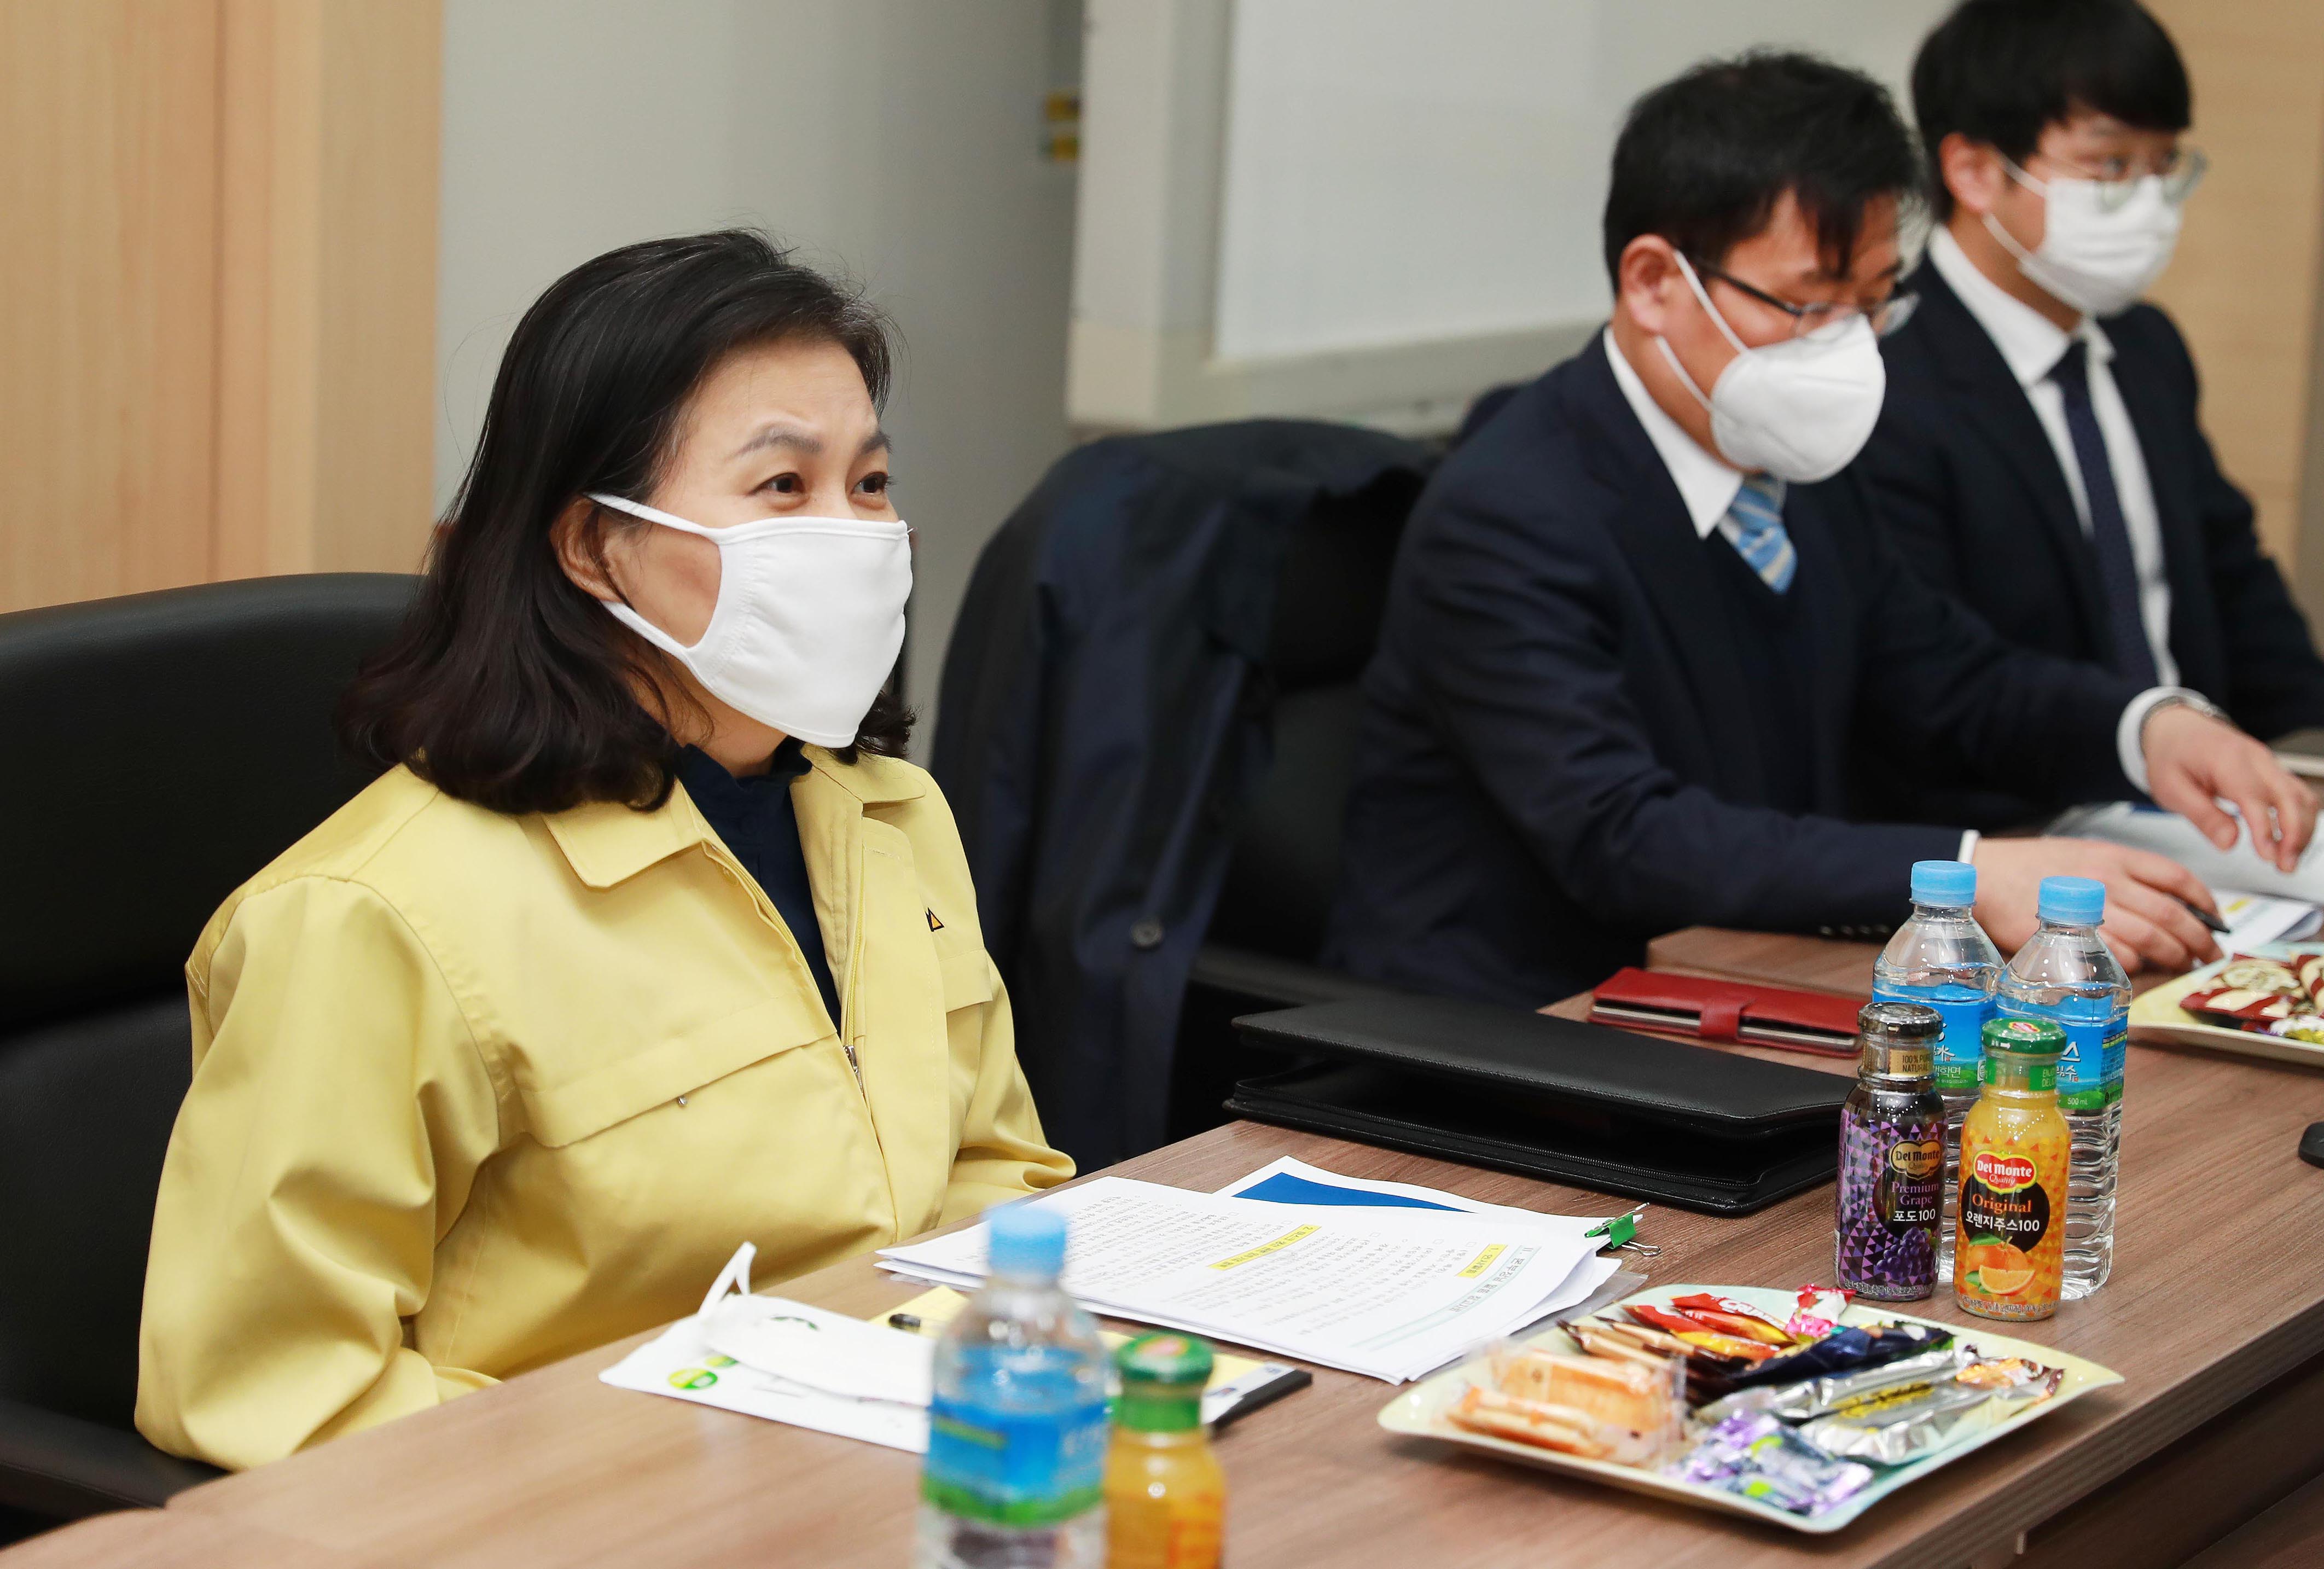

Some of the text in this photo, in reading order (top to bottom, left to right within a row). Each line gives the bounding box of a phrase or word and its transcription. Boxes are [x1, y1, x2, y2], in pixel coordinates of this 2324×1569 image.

[1896, 1150, 1939, 1161] Del Monte
[1977, 1160, 2032, 1177] Del Monte
[1989, 1174, 2016, 1186] Quality
[1891, 1181, 1939, 1194] Premium
[1900, 1194, 1933, 1208] Grape
[1972, 1193, 2032, 1214] Original
